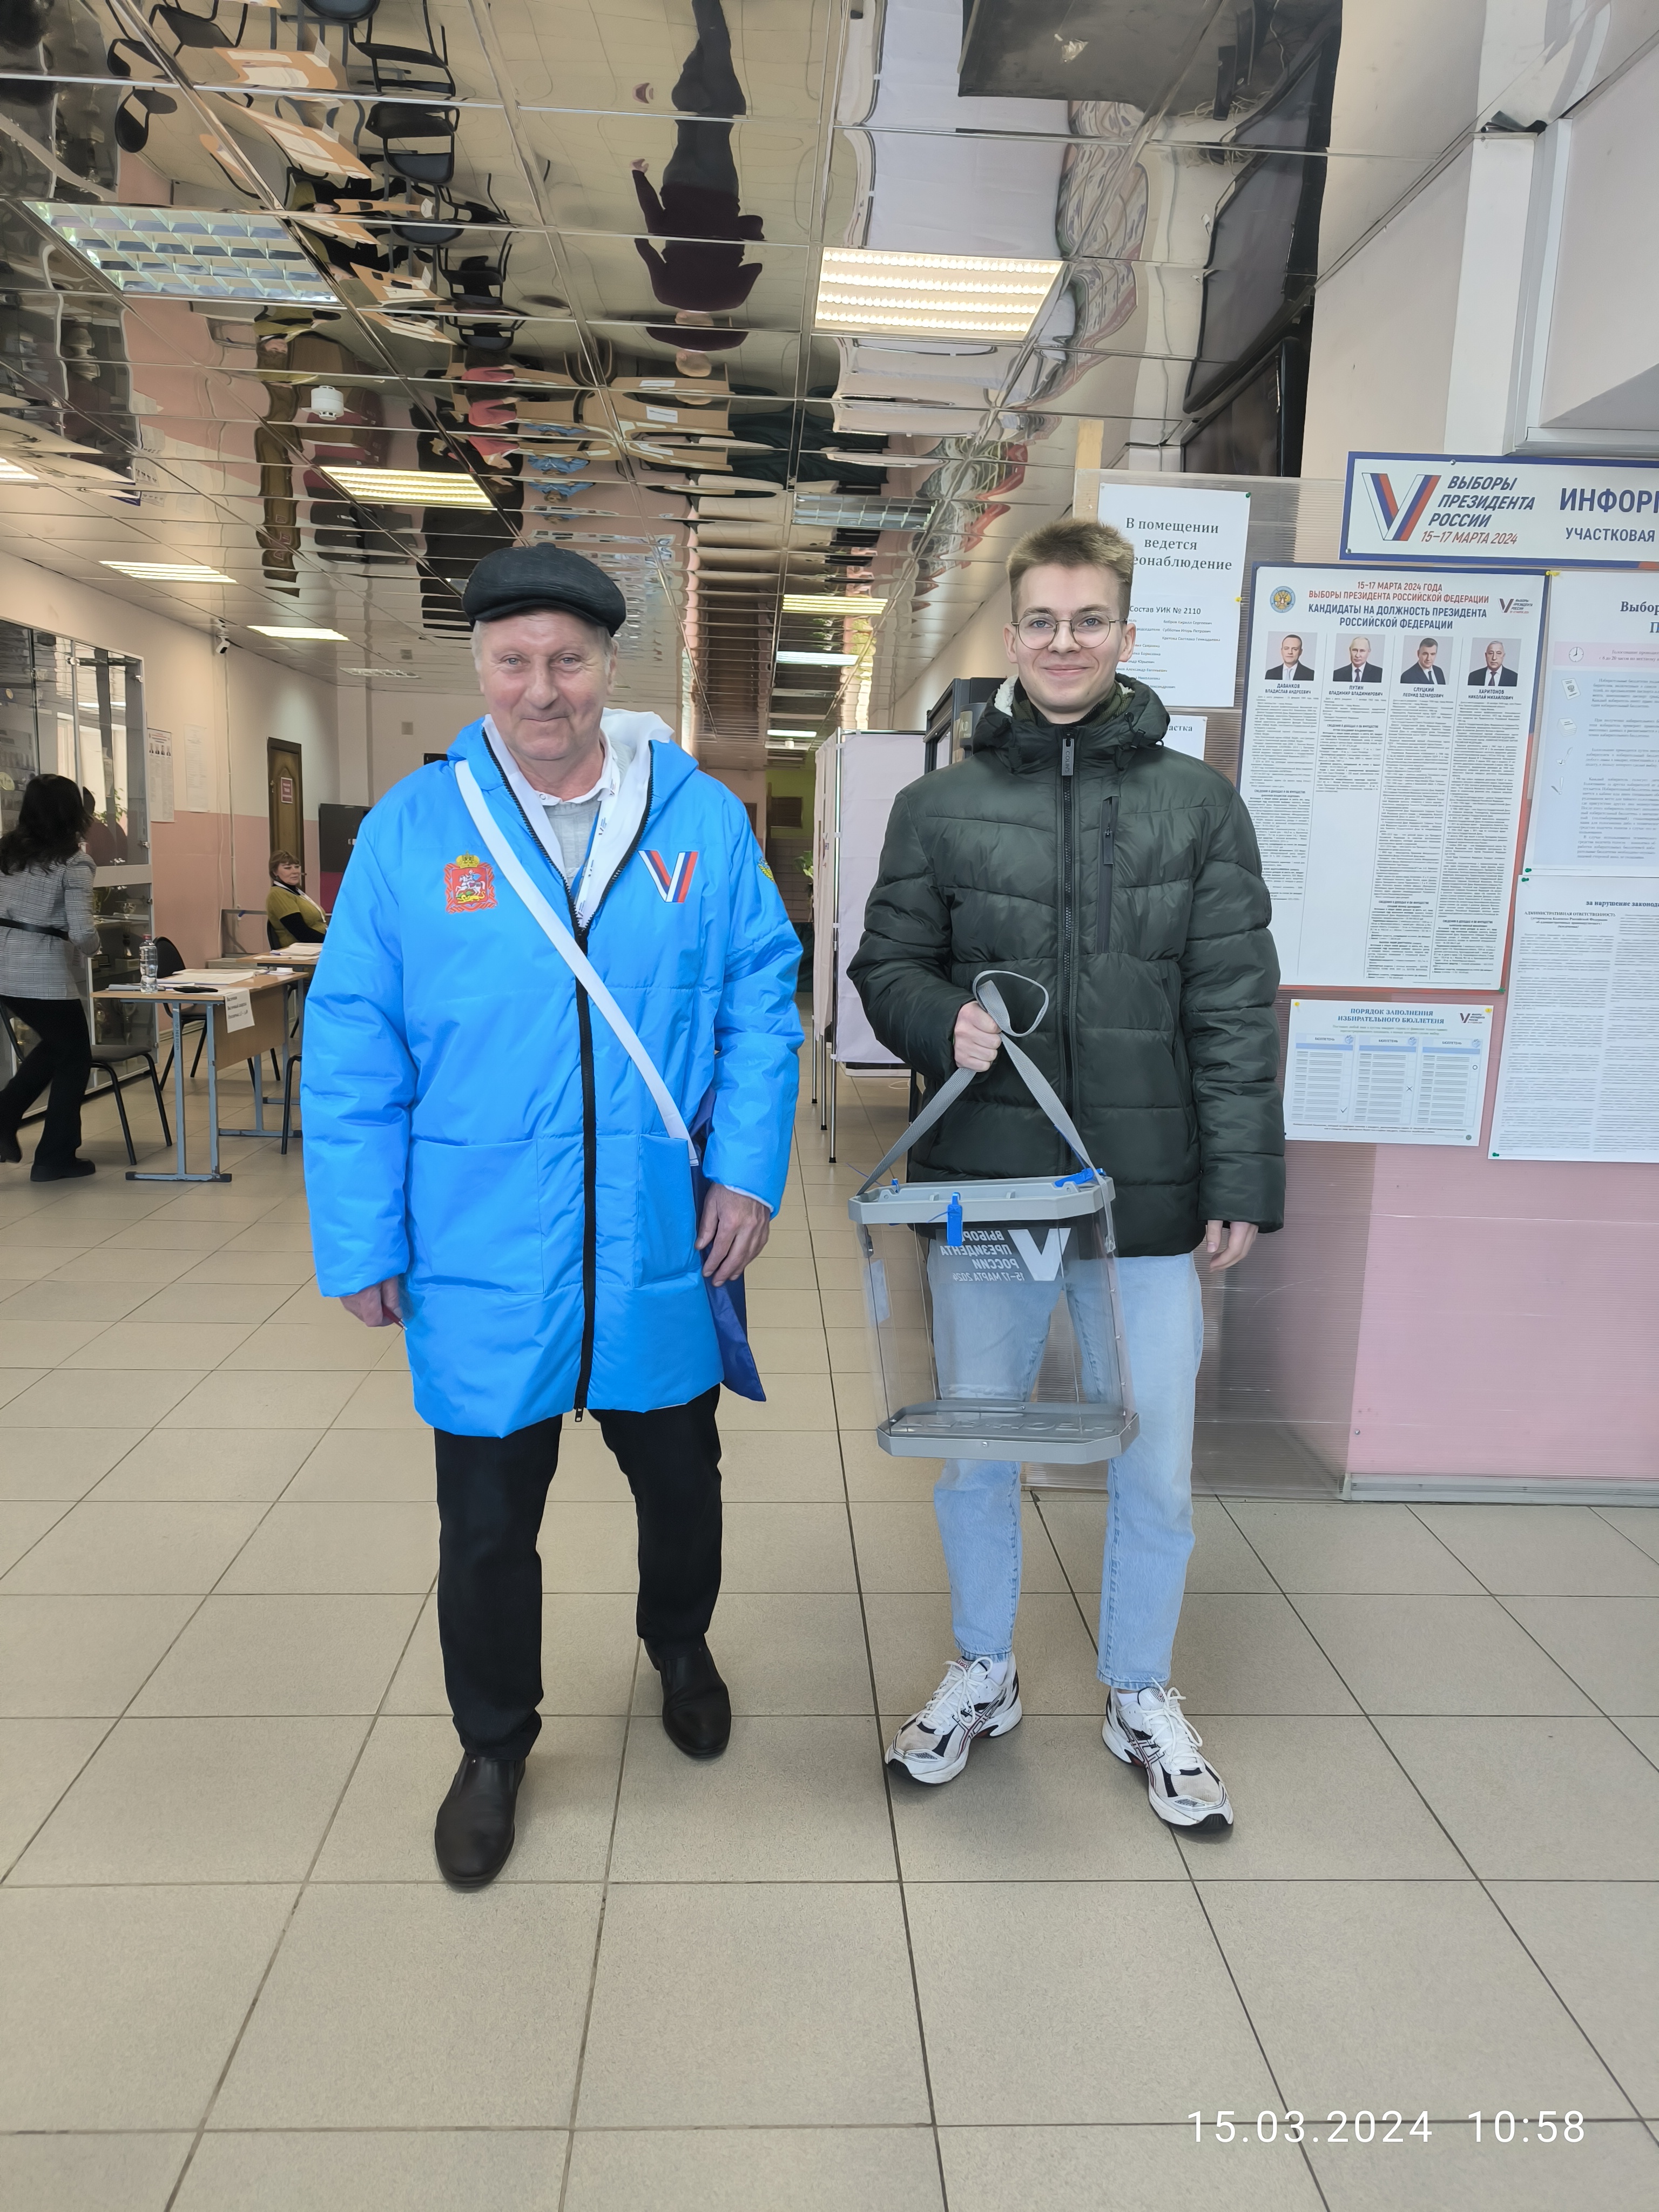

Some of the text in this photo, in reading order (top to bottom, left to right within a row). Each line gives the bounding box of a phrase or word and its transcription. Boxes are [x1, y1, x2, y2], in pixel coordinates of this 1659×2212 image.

[1447, 476, 1518, 491] ВЫБОРЫ
[1438, 494, 1535, 511] ПРЕЗИДЕНТА
[1560, 488, 1659, 514] ИНФОР
[1125, 517, 1219, 536] В помещении
[1428, 512, 1492, 528] РОССИИ
[1452, 531, 1491, 544] МАРТА
[1491, 532, 1518, 544] 2024
[1566, 527, 1656, 542] УЧАСТКОВАЯ
[1144, 538, 1198, 552] ведется
[1132, 556, 1232, 570] еонаблюдение
[1377, 582, 1402, 591] МАРТА
[1403, 583, 1422, 591] 2024
[1423, 583, 1443, 592] ГОДА
[1309, 590, 1489, 604] ВЫБОРЫ ПРЕЗИДЕНТА РОССИЙСКОЙ ФЕДЕРАЦИИ
[1308, 603, 1487, 618] КАНДИДАТЫ НА ДОЛЖНОСТЬ ПРЕЗИДЕНТА
[1339, 616, 1453, 630] РОССИЙСКОЙ ФЕДЕРАЦИИ
